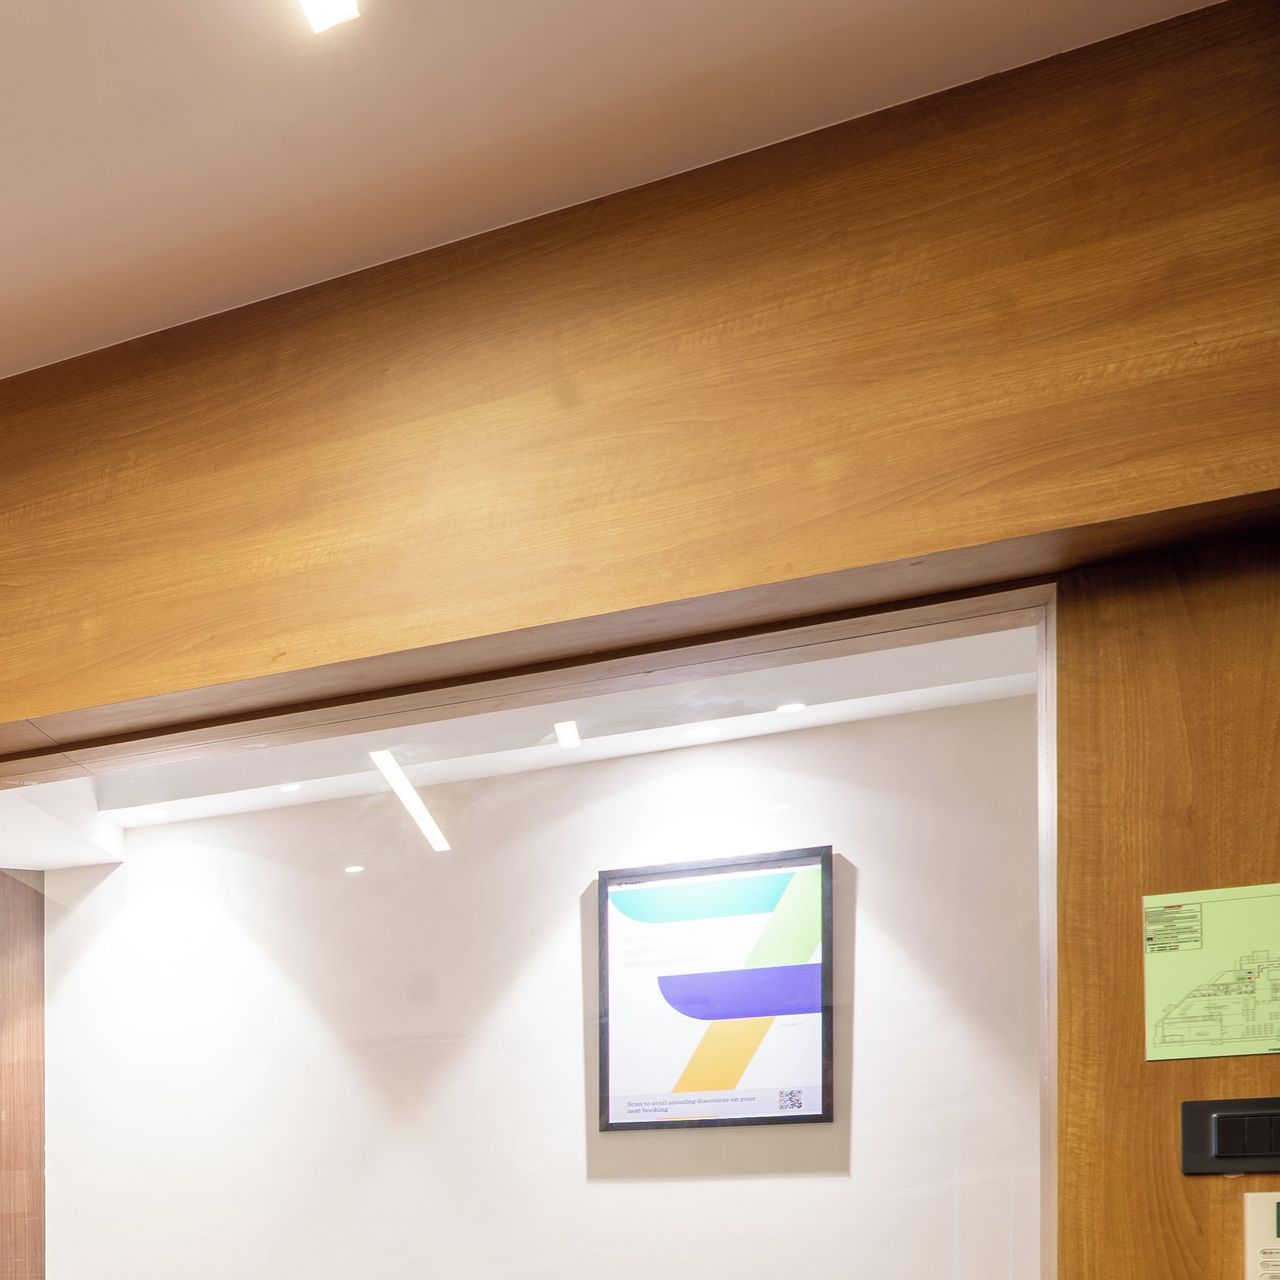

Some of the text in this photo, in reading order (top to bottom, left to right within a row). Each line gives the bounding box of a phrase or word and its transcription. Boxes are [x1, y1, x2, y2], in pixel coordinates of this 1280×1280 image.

[668, 1098, 696, 1106] amazing
[697, 1096, 730, 1104] discounts
[642, 1106, 669, 1114] booking
